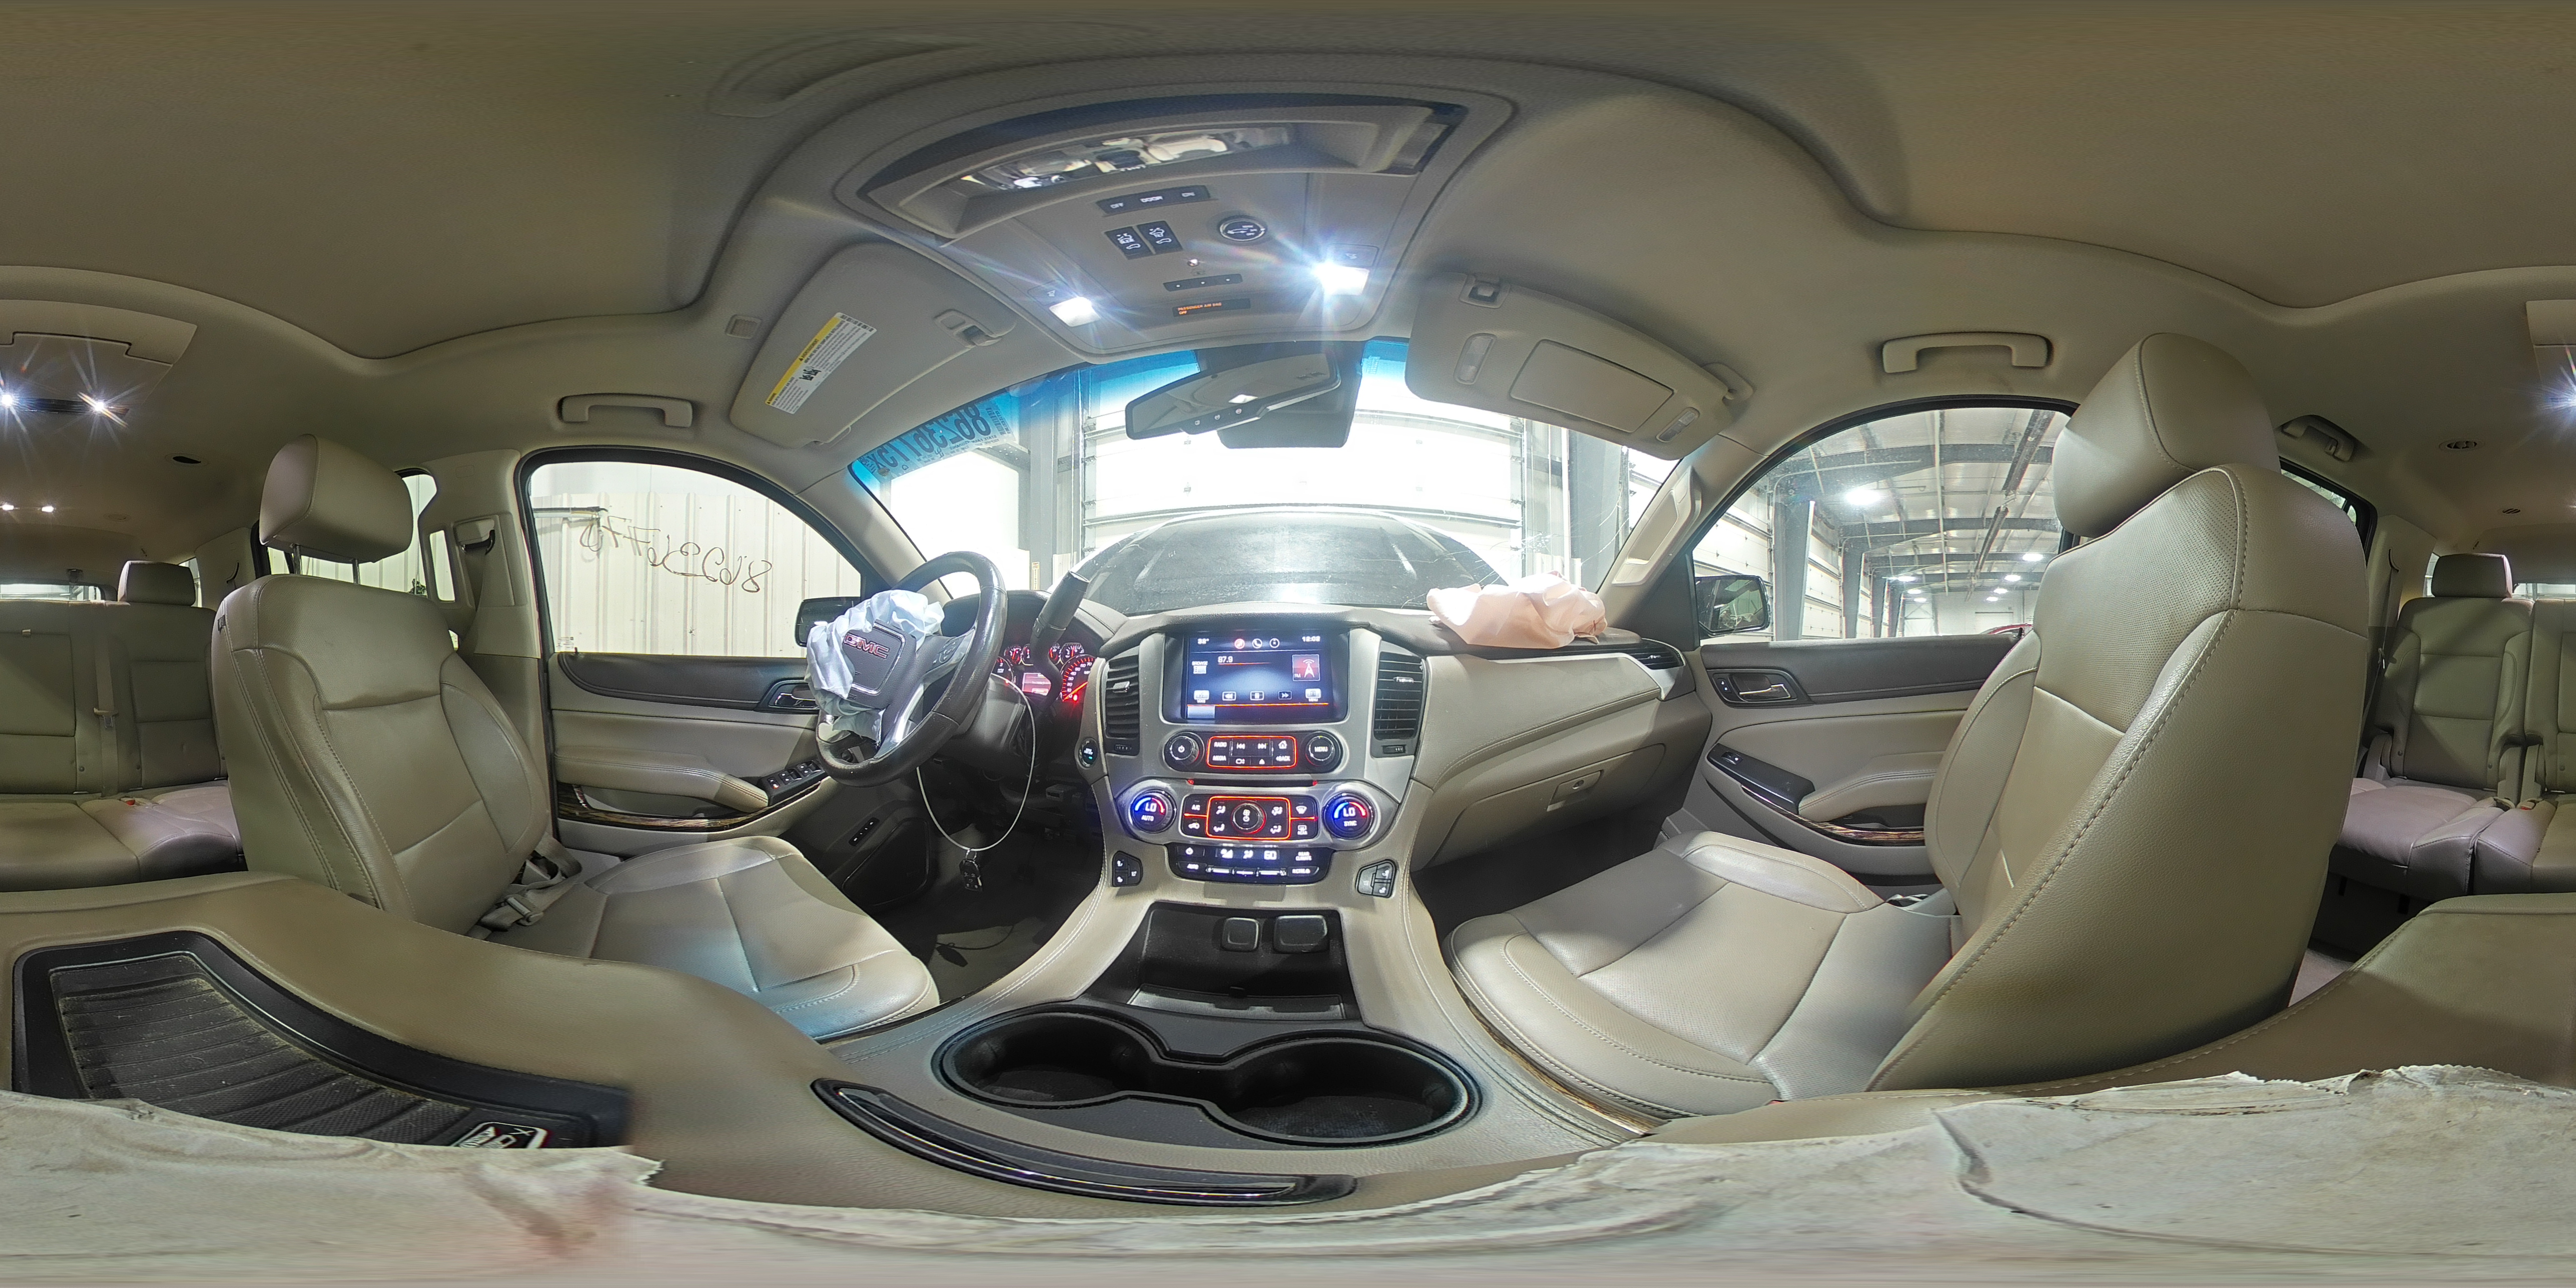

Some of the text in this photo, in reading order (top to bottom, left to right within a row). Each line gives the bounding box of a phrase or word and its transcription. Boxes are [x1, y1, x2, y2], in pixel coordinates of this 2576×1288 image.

[844, 632, 890, 659] GMC
[1145, 803, 1157, 812] LO
[1343, 807, 1356, 817] LO
